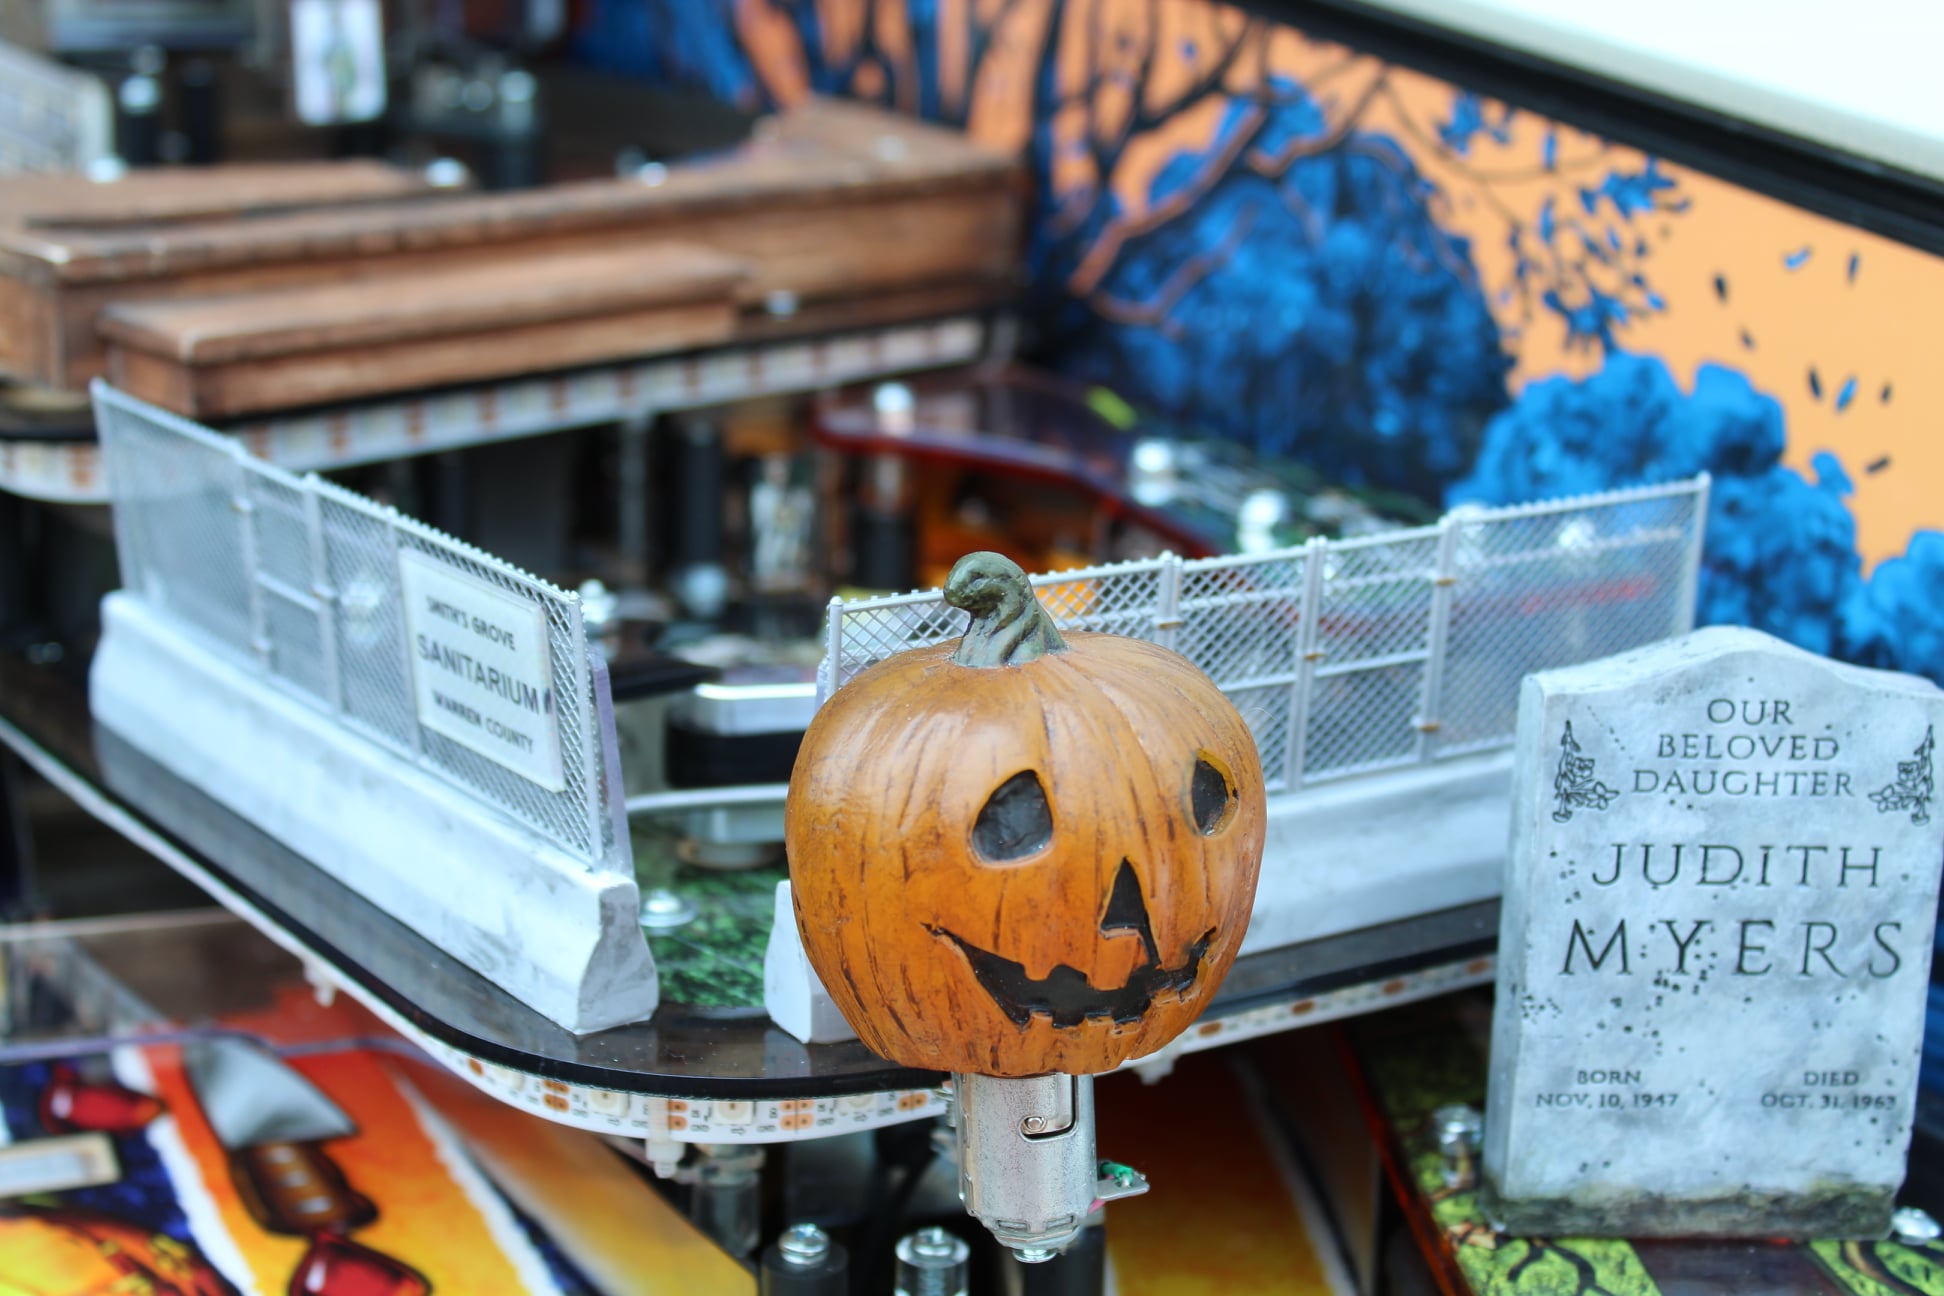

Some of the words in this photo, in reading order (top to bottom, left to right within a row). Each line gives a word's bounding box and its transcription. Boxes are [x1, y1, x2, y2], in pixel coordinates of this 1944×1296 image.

[472, 616, 516, 651] GROVE
[417, 634, 539, 715] SANITARIUM
[1707, 698, 1794, 726] OUR
[486, 717, 534, 754] COUNTY
[1657, 735, 1839, 761] BELOVED
[1633, 770, 1856, 797] DAUGHTER
[1592, 844, 1883, 888] JUDITH
[1558, 918, 1903, 979] MYERS
[1577, 1070, 1641, 1085] BORN
[1803, 1071, 1860, 1086] DIED
[1633, 1093, 1679, 1108] 1947
[1852, 1095, 1897, 1110] 1963
